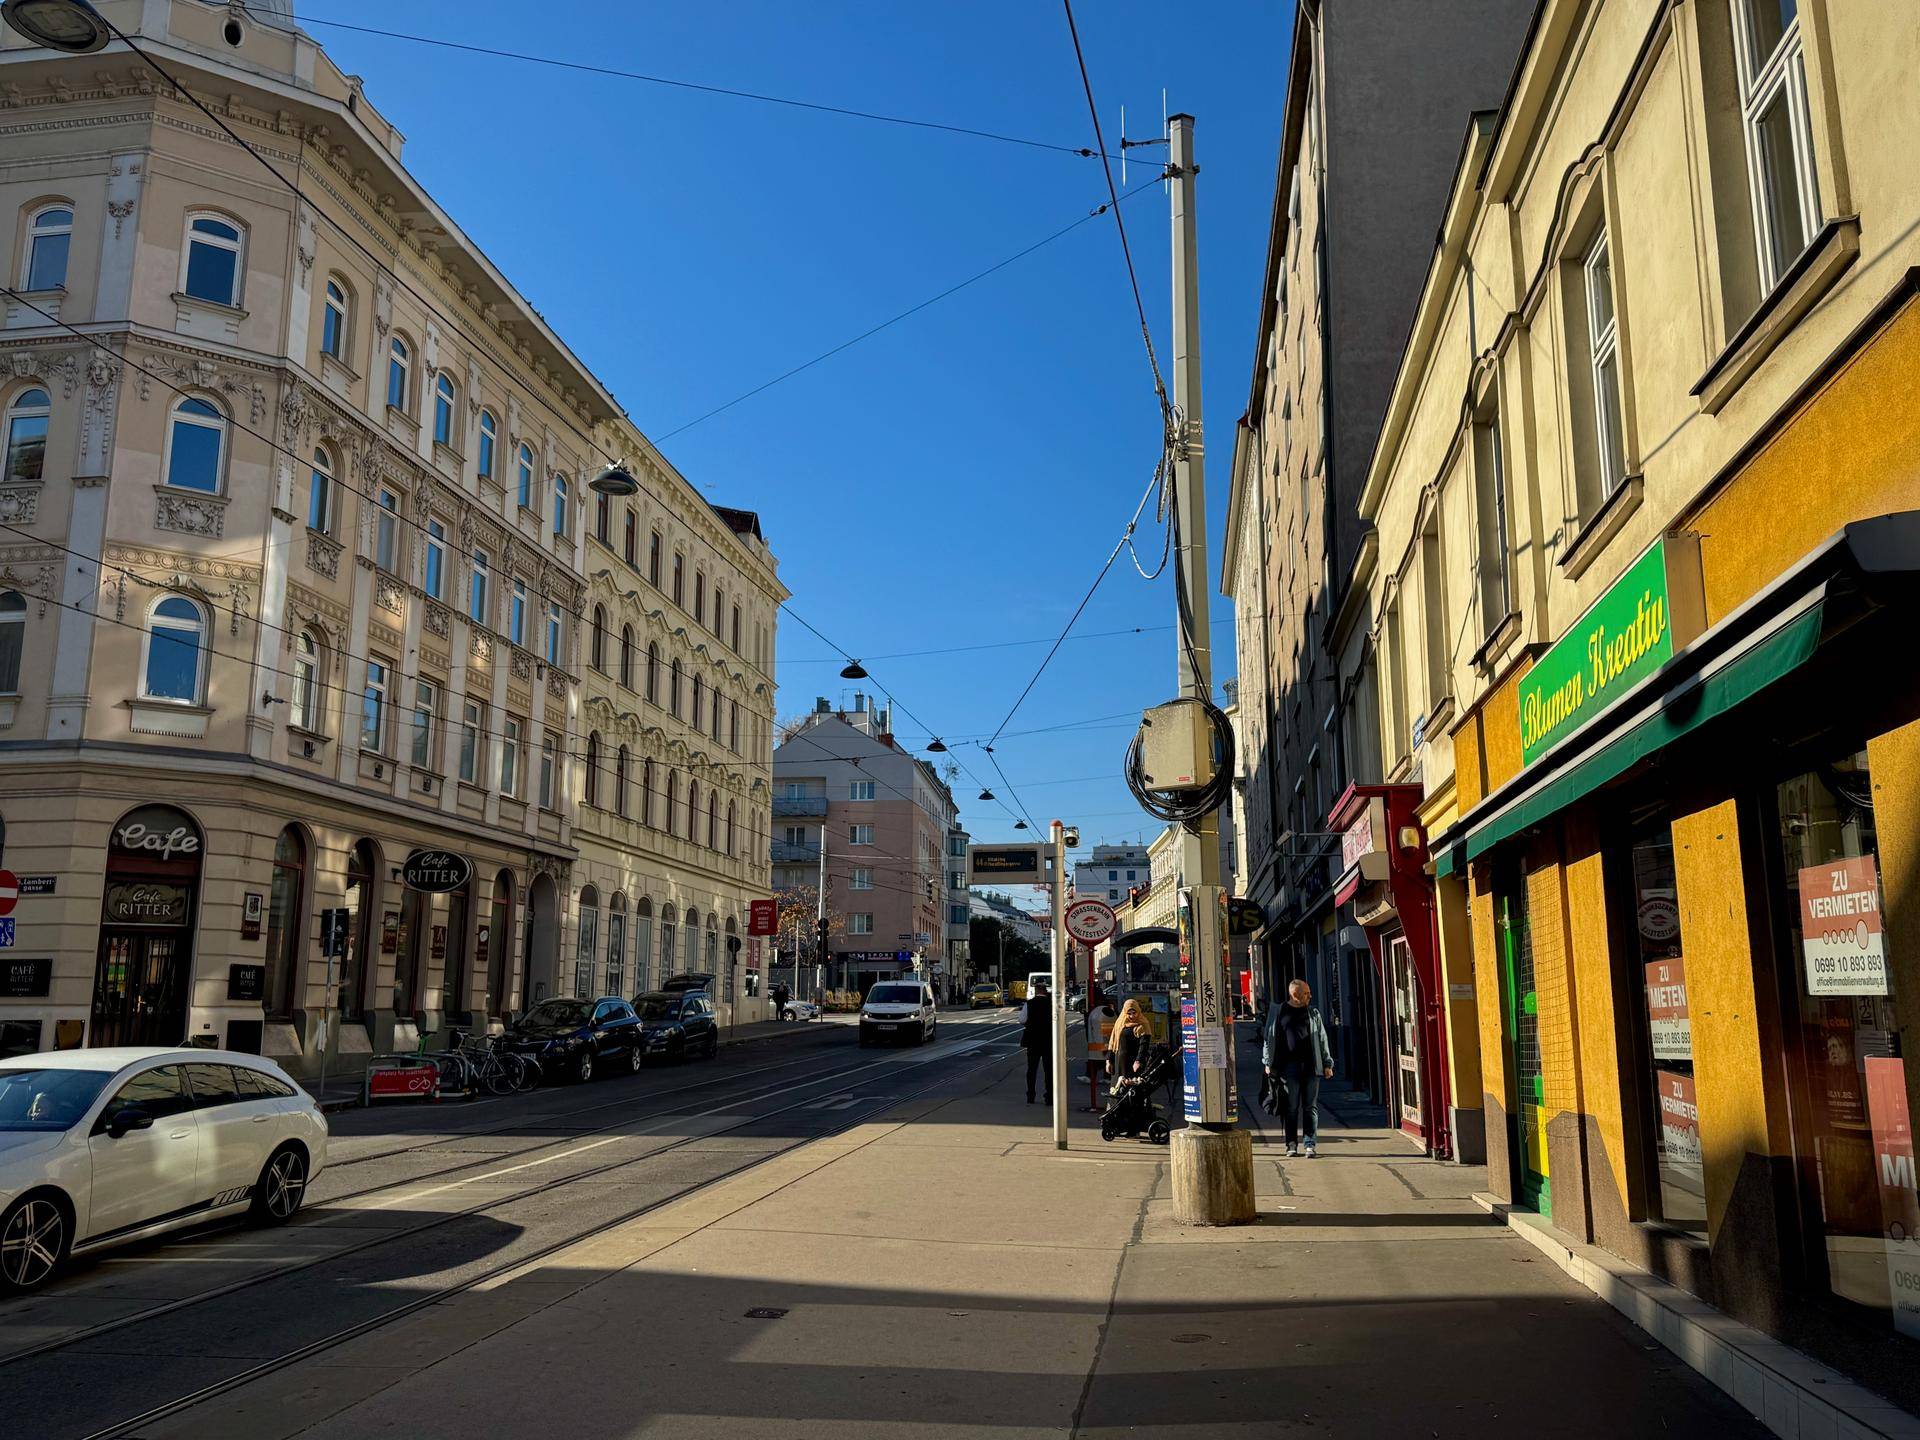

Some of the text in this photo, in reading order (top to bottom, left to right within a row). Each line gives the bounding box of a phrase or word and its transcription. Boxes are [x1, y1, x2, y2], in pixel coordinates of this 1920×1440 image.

[1524, 588, 1666, 749] Blumen Kreativ
[407, 869, 459, 883] RITTER
[1831, 869, 1848, 892] ZU
[119, 902, 171, 916] RITTER
[1070, 905, 1112, 920] STRASSENBAHN
[1808, 890, 1877, 919] VERMIETEN
[1073, 925, 1109, 938] HALTESTELLE
[1815, 954, 1882, 973] 0699 10 893 893
[1659, 965, 1669, 982] ZU
[1650, 985, 1686, 1008] MIETEN
[1672, 1081, 1683, 1098] ZU
